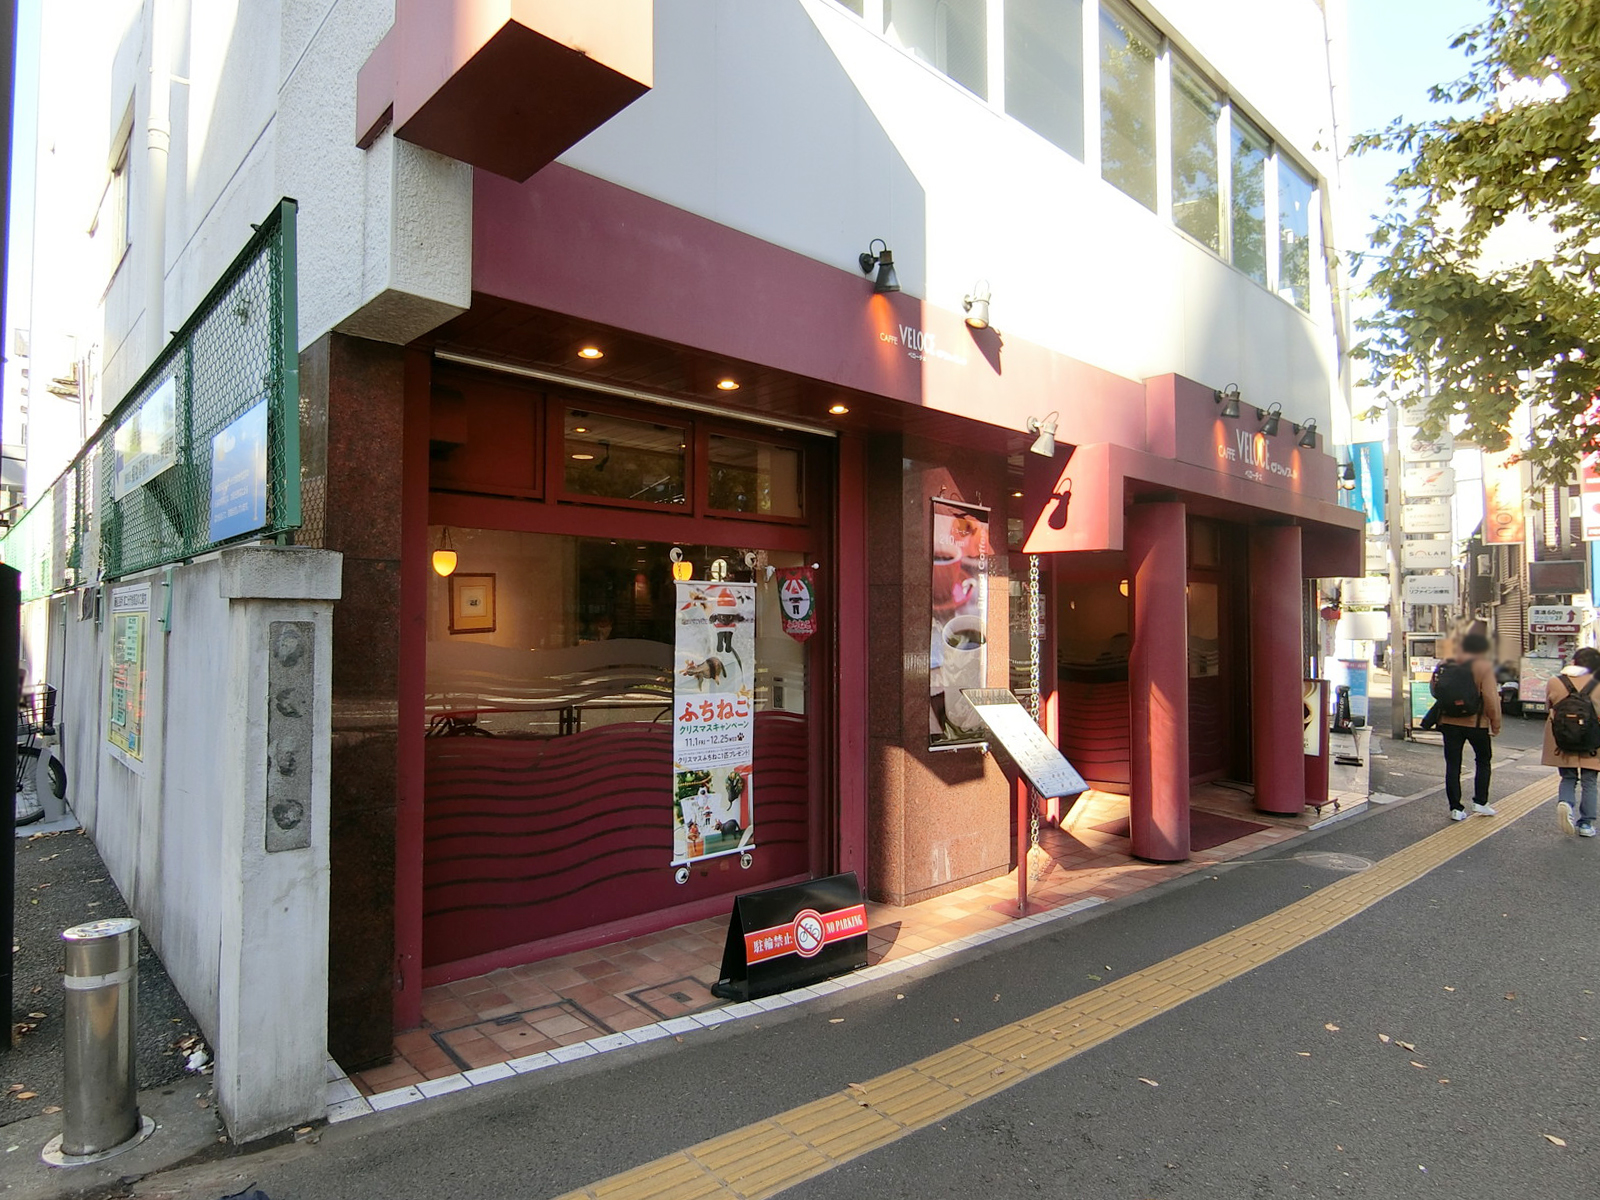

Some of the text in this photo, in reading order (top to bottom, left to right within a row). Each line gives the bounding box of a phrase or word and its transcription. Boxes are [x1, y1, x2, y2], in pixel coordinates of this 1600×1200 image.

[679, 699, 748, 722] ふちねこ
[680, 721, 749, 735] クリスマスキャンペーン
[826, 914, 863, 934] NO PARKING
[753, 932, 793, 953] 駐輪禁止
